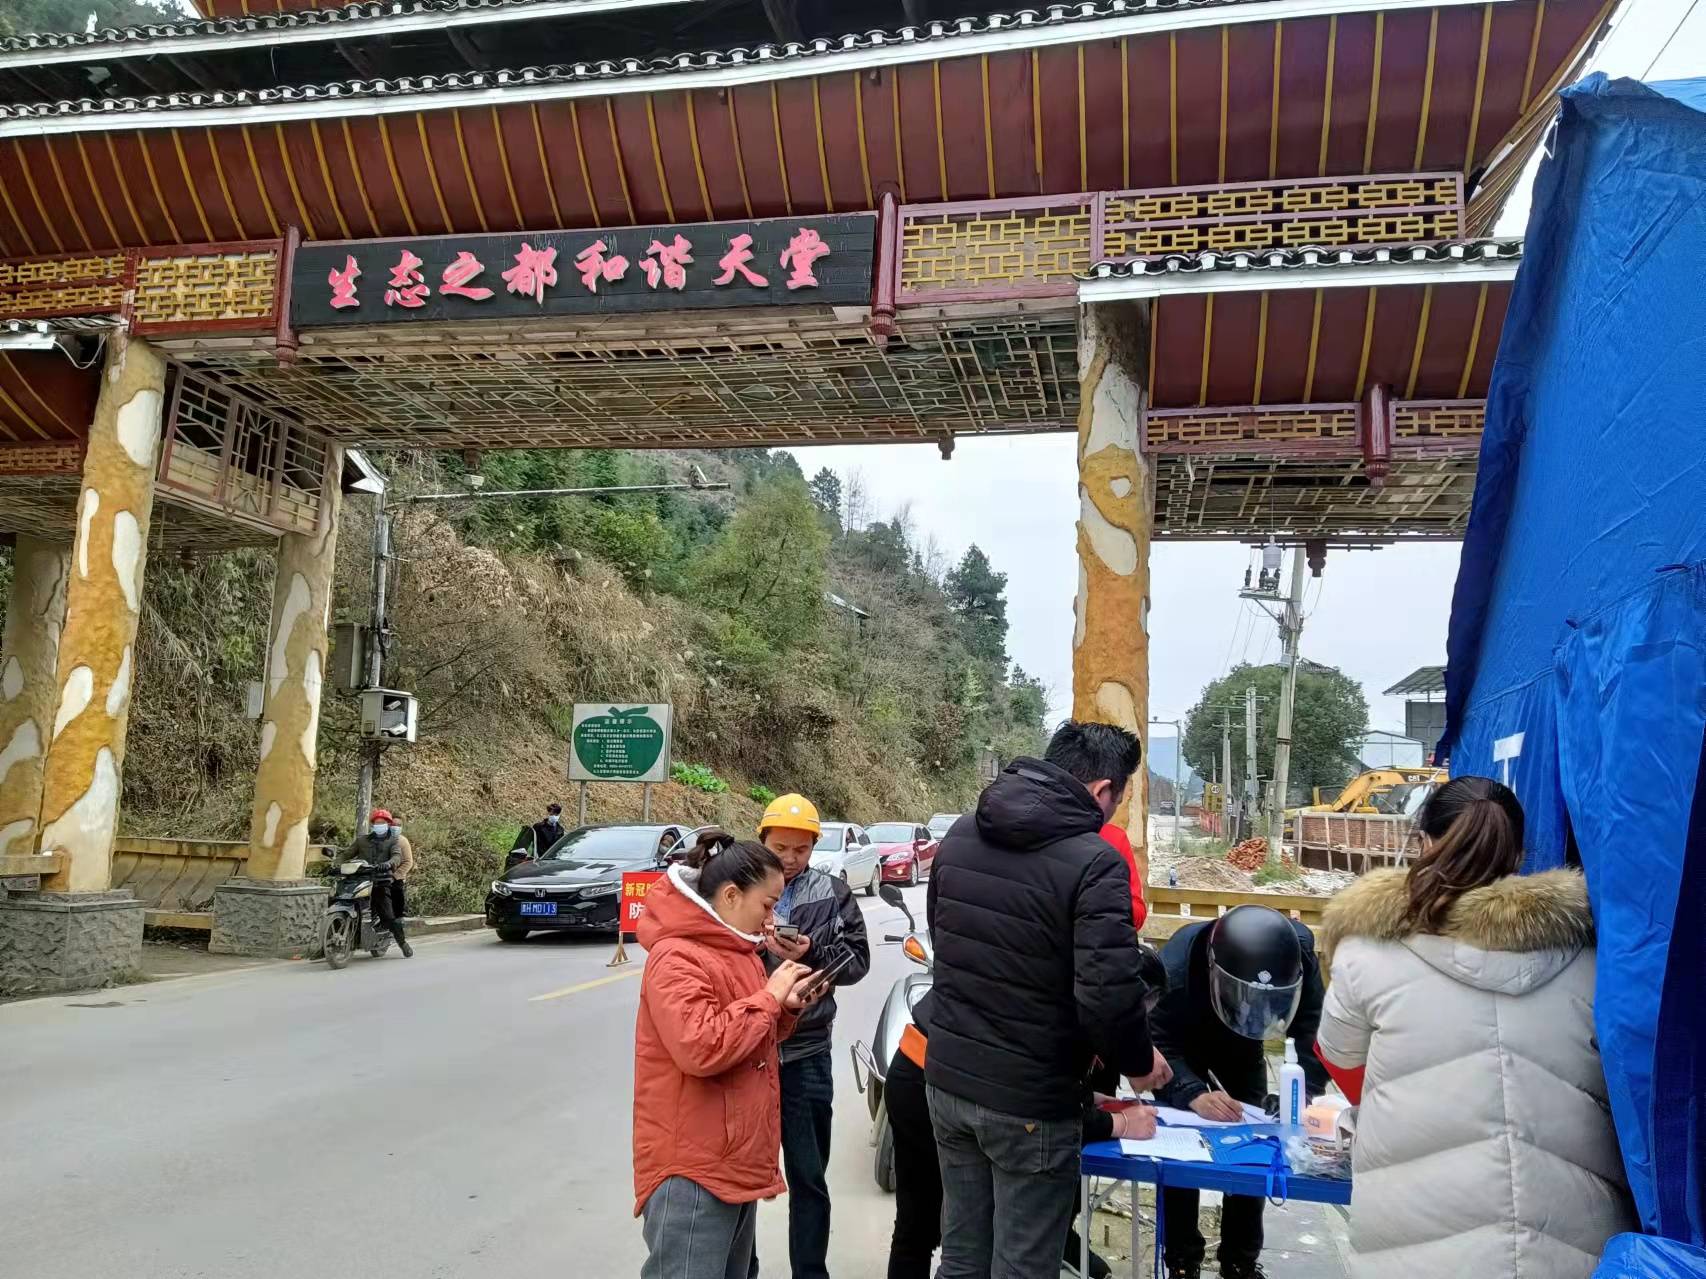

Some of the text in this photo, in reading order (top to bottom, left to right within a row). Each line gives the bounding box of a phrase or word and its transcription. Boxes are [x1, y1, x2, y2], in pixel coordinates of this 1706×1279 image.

[328, 227, 831, 308] 生态之都和谐天堂
